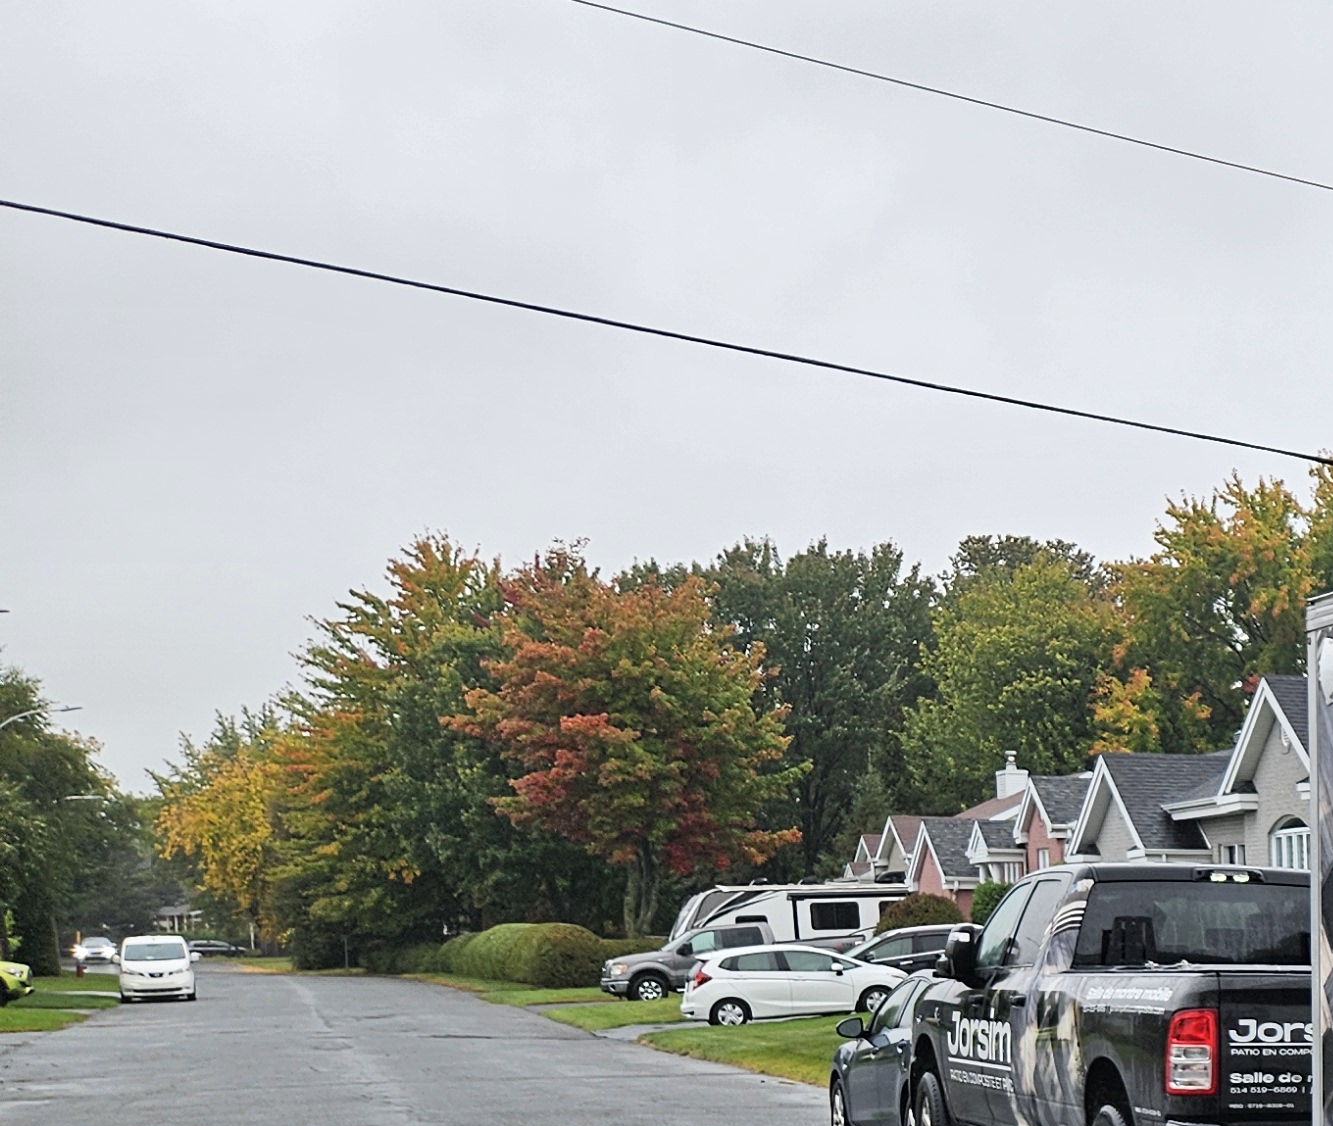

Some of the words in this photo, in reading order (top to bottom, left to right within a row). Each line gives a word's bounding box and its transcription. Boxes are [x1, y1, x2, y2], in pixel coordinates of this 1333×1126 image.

[947, 1007, 1012, 1063] Jorsim
[1230, 1048, 1260, 1056] PATIO
[1262, 1048, 1277, 1056] EN
[1279, 1048, 1312, 1056] COMP
[1229, 1072, 1275, 1084] Salle
[1278, 1072, 1302, 1084] de
